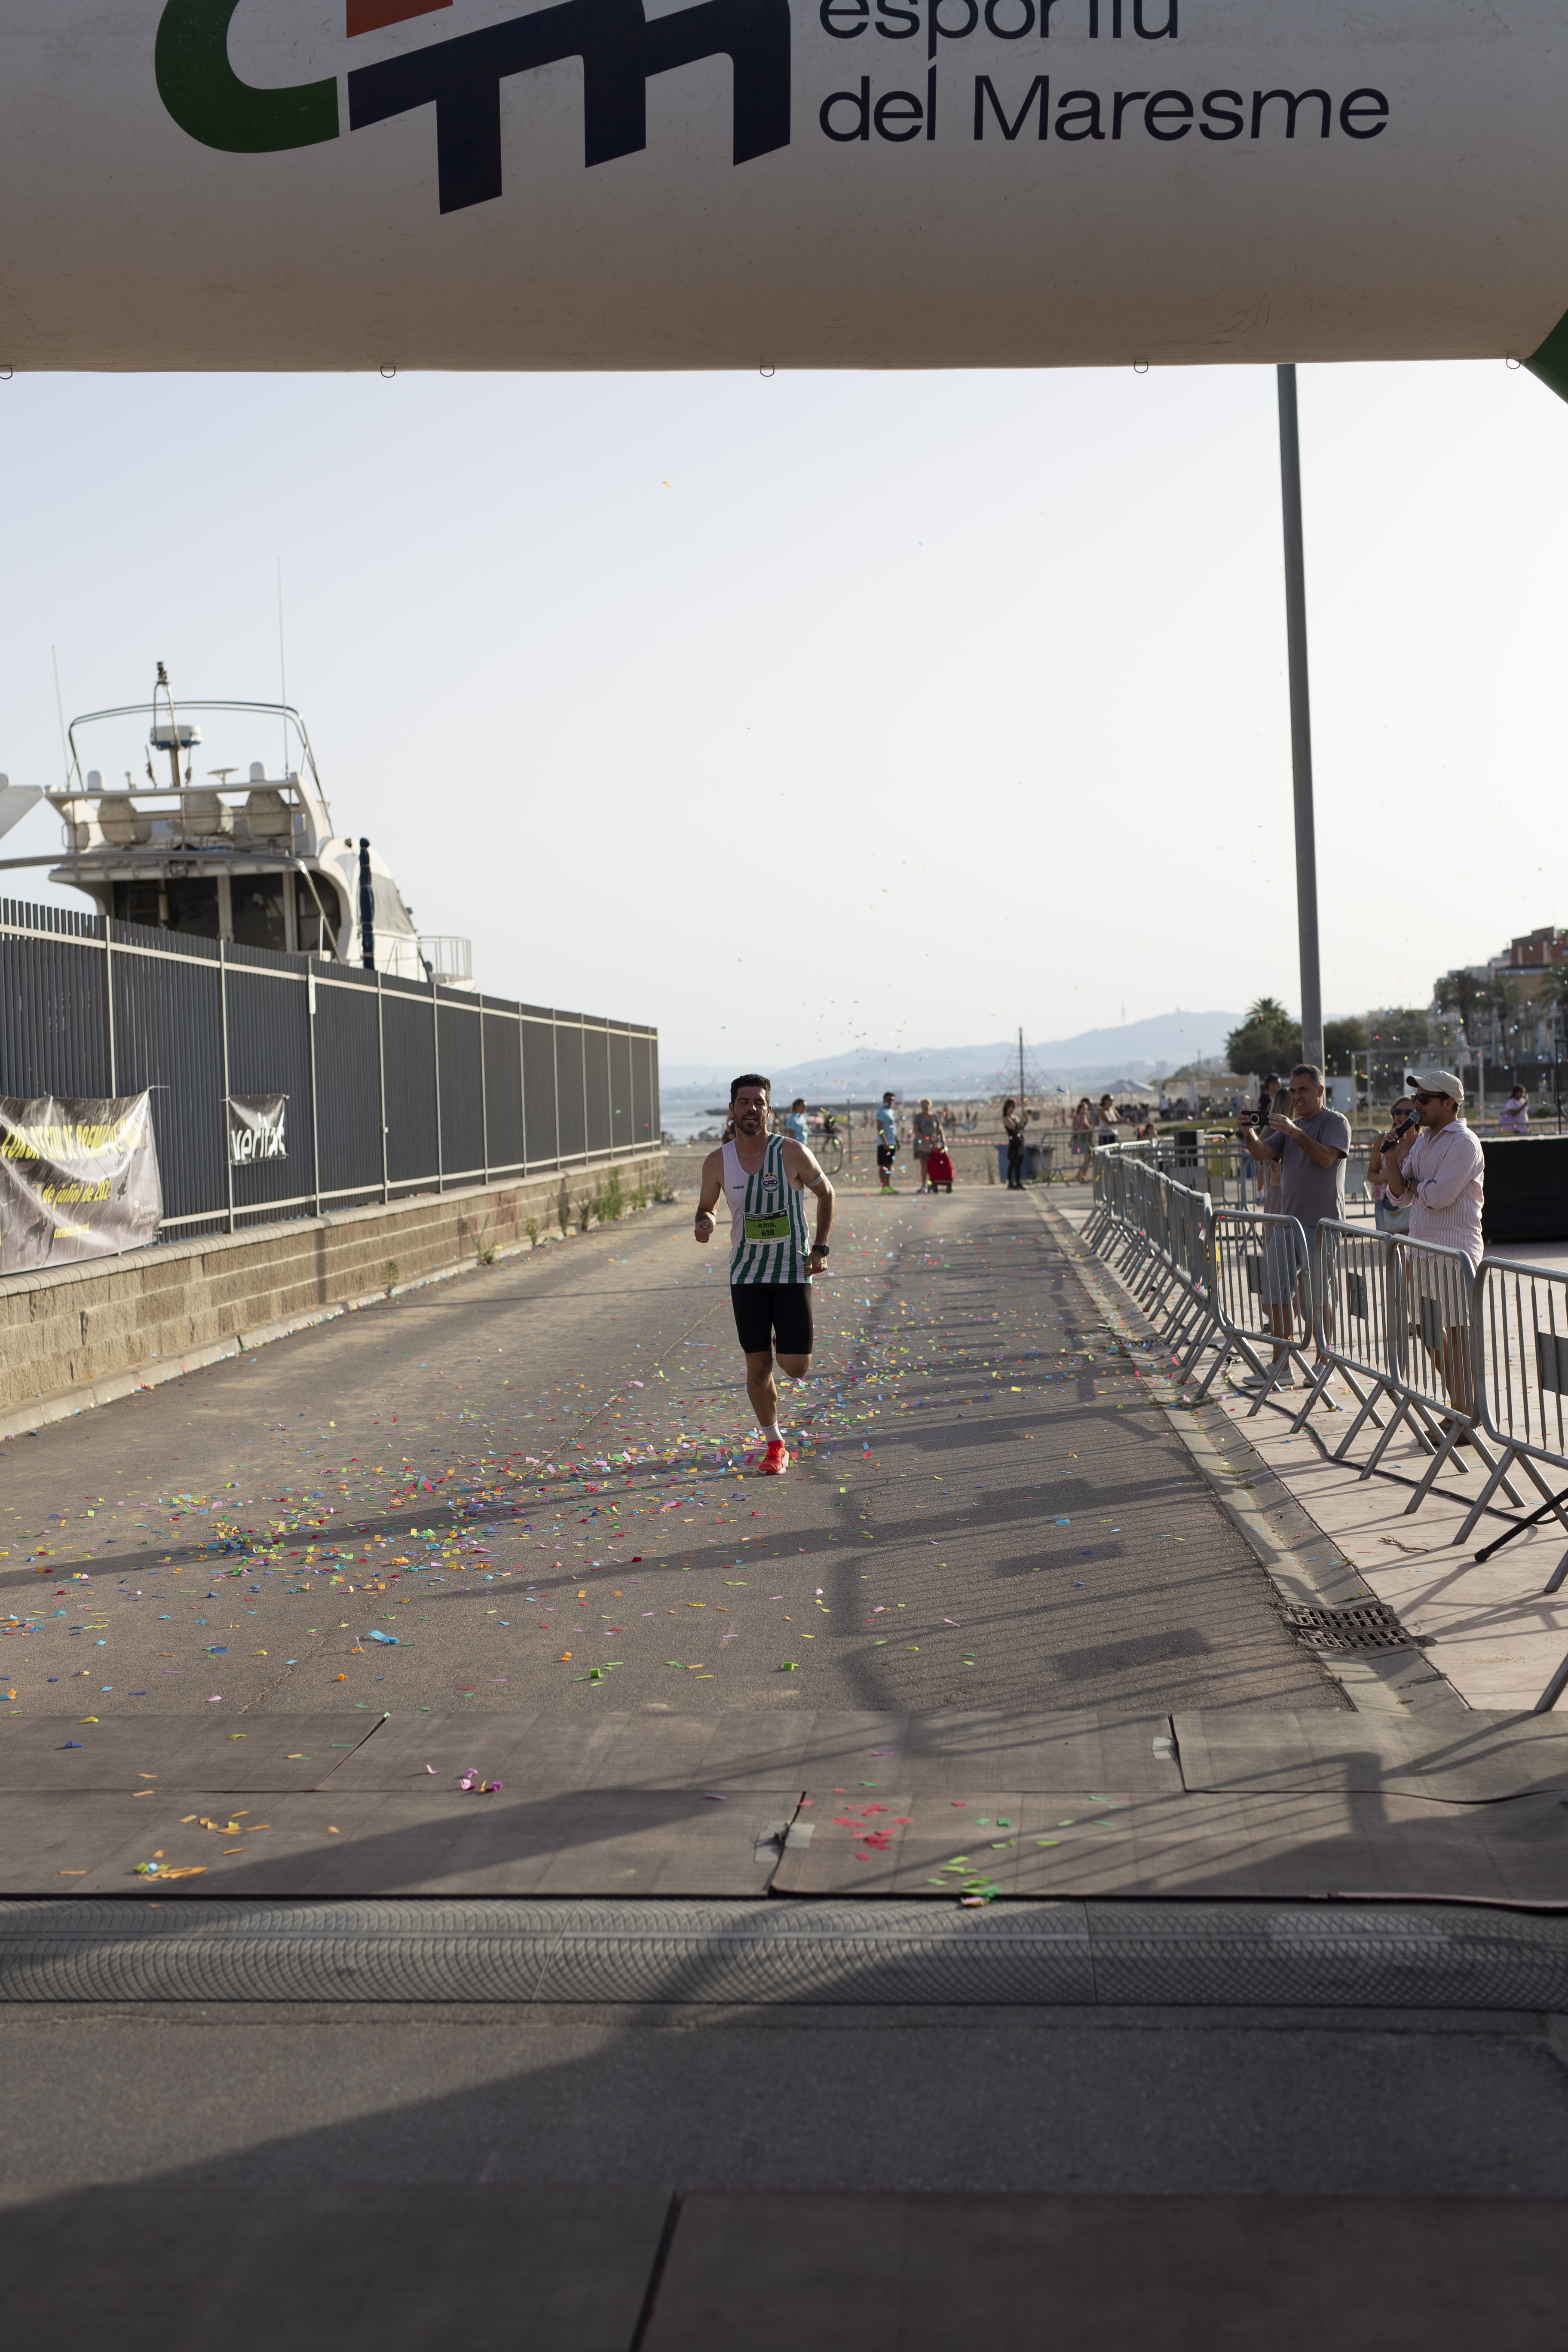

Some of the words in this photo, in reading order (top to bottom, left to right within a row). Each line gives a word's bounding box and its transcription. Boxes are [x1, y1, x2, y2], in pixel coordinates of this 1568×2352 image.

[819, 63, 937, 142] del
[974, 75, 1389, 141] Maresme
[42, 1183, 55, 1204] de
[52, 1182, 84, 1210] juliol
[81, 1182, 94, 1203] de
